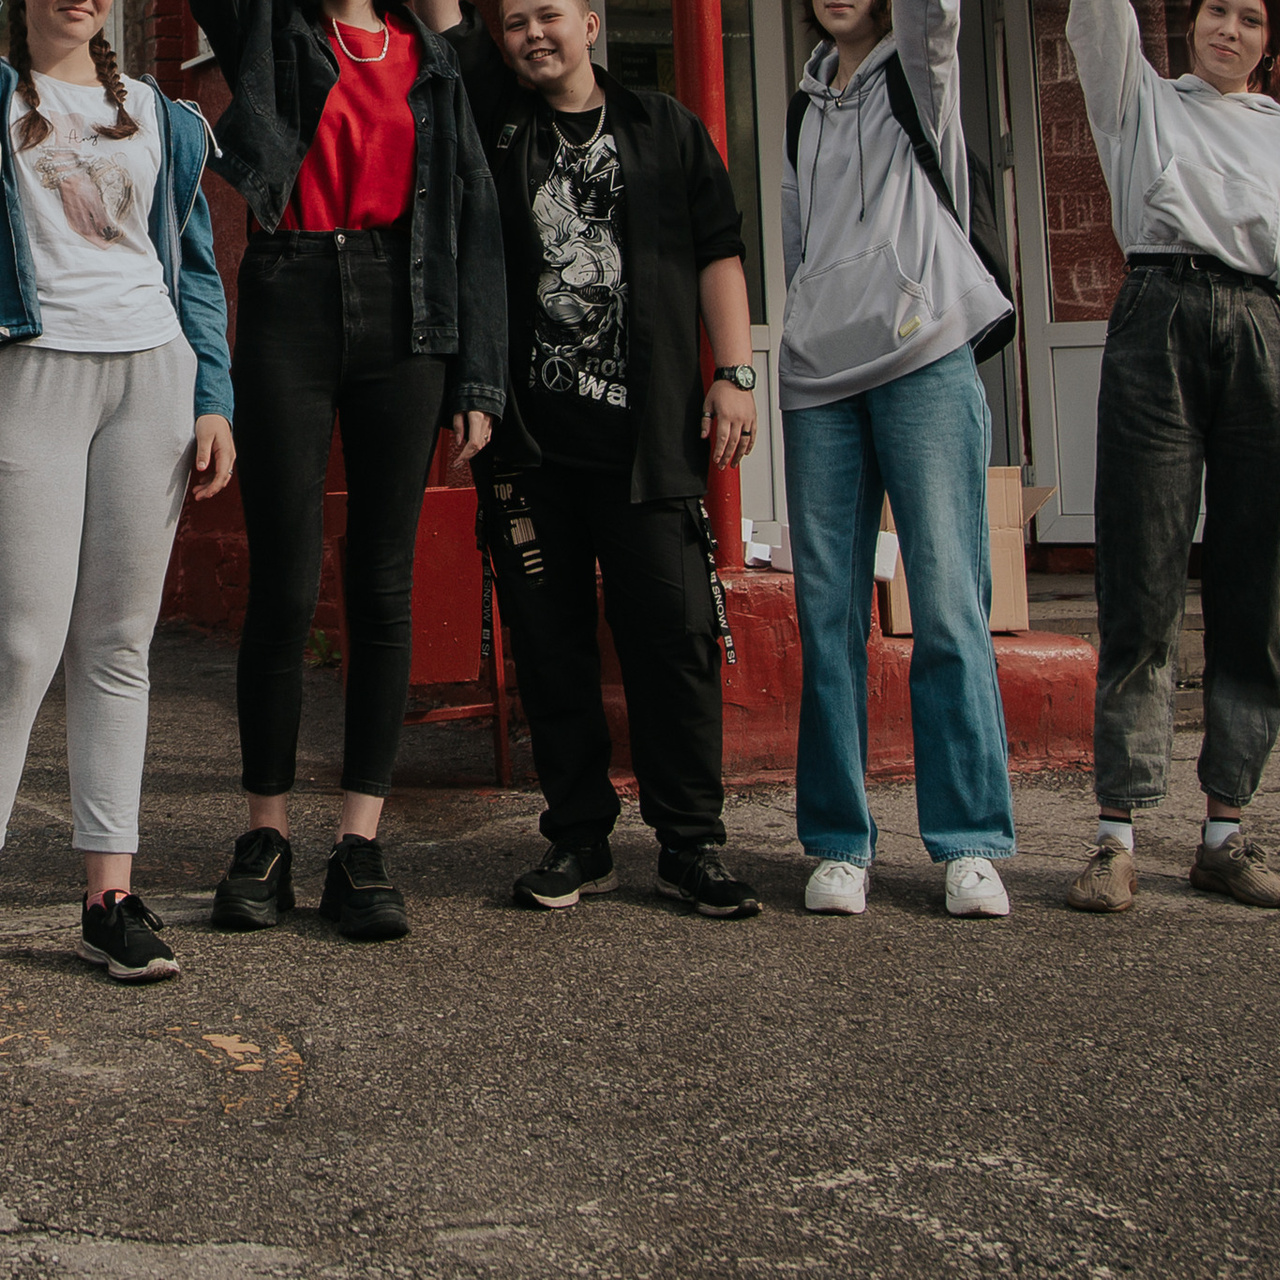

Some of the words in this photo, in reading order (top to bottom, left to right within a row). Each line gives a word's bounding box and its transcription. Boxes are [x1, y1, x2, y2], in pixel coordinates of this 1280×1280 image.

[584, 355, 627, 378] not
[577, 371, 630, 409] wa
[492, 483, 514, 501] TOP
[482, 578, 492, 623] SNOW
[711, 585, 729, 629] SNOW
